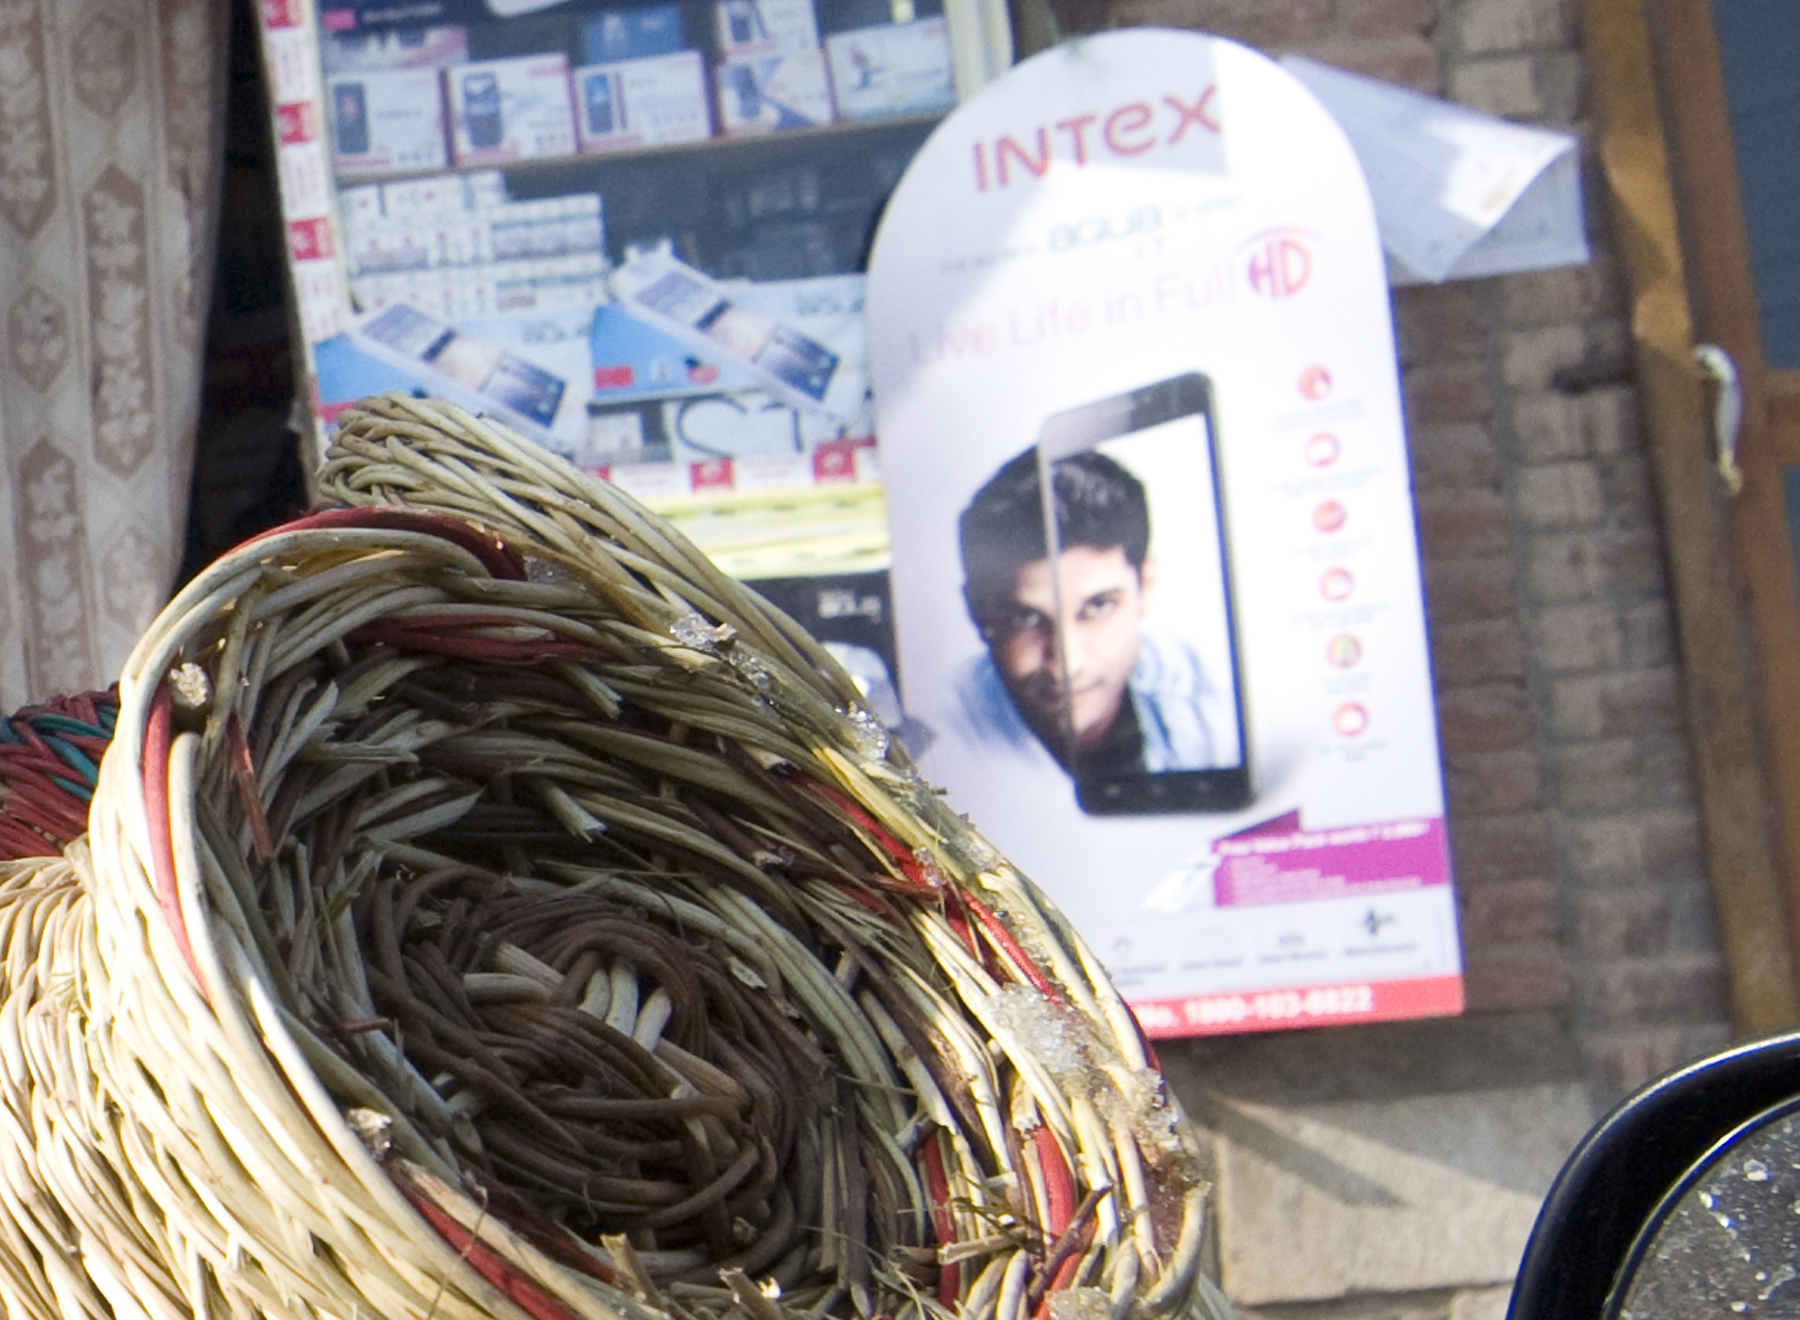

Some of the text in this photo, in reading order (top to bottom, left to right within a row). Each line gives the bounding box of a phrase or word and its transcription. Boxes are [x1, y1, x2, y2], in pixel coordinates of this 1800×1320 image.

[1008, 299, 1092, 347] Life
[1103, 283, 1145, 328] in
[1153, 262, 1237, 315] Full
[1247, 237, 1313, 300] HD
